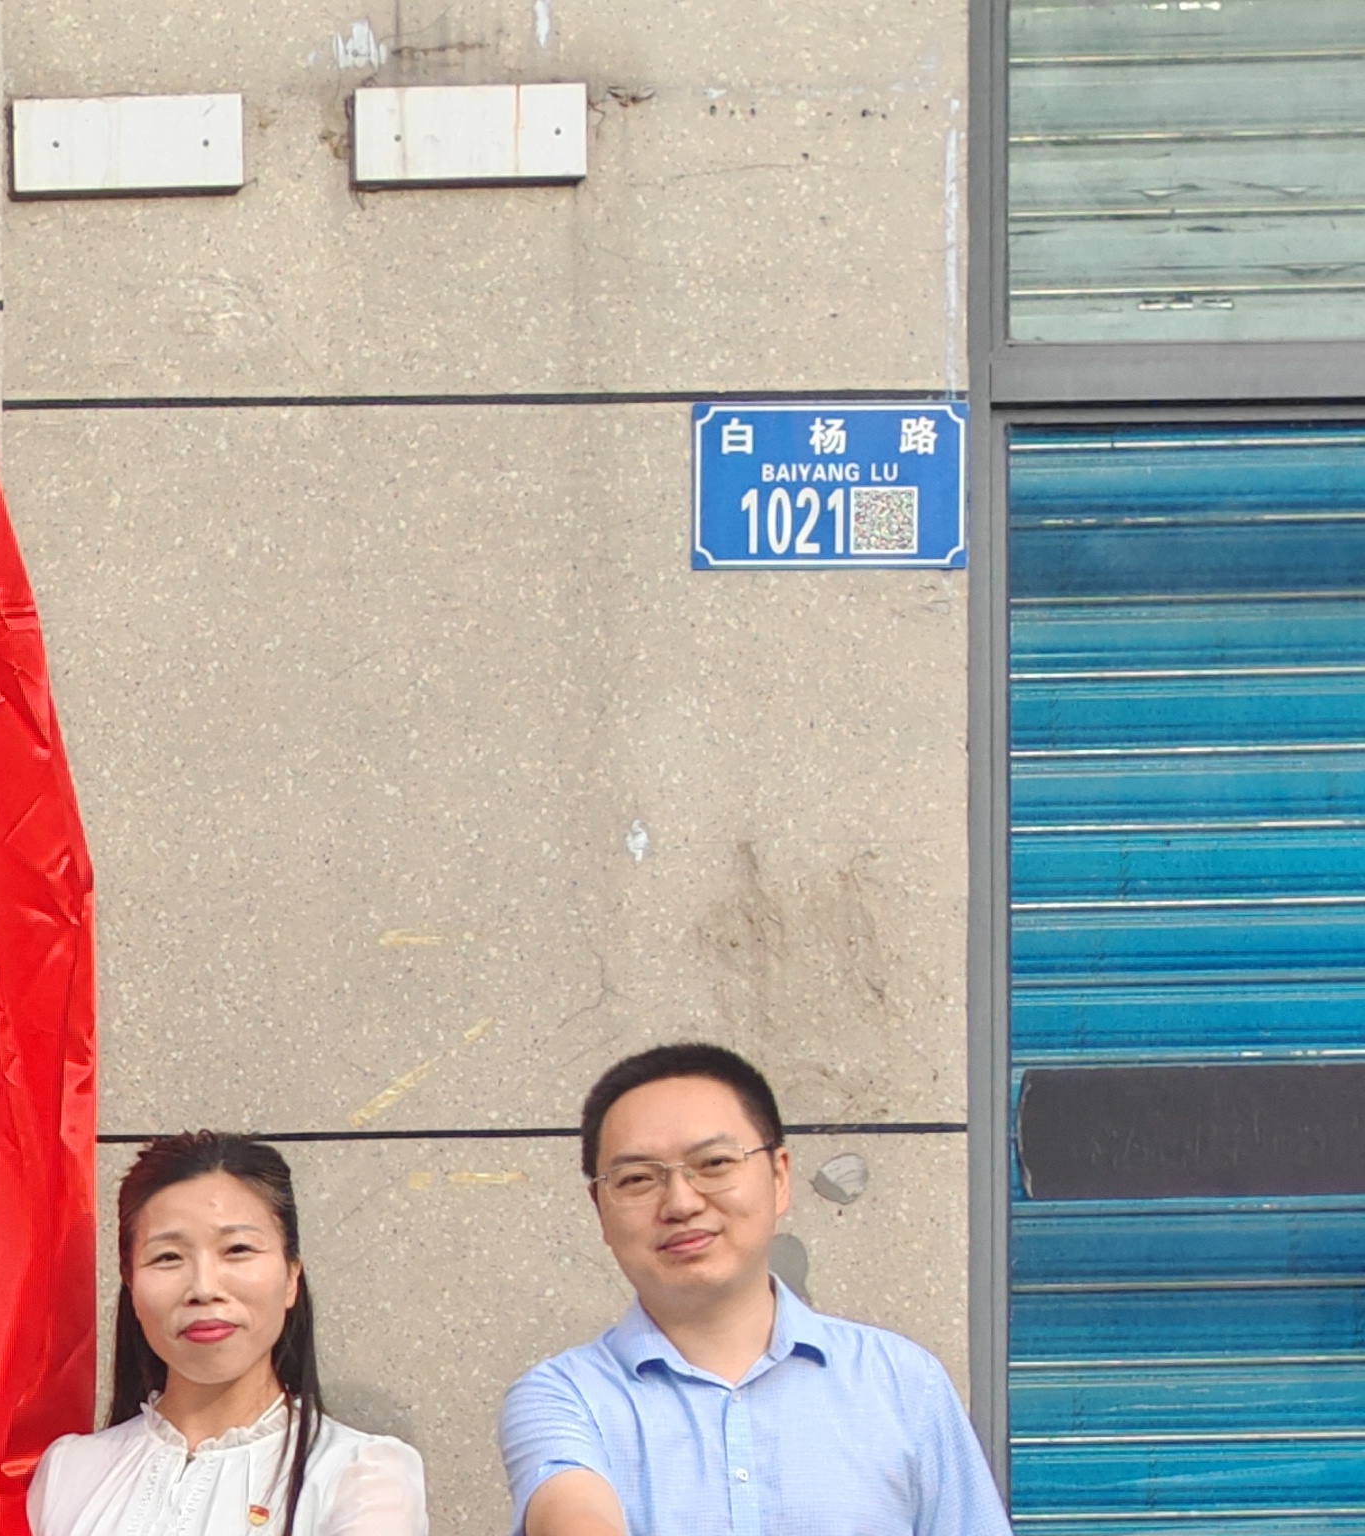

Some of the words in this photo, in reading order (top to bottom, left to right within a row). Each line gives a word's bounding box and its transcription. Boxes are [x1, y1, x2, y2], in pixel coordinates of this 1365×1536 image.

[721, 417, 938, 455] 白杨路
[761, 462, 860, 483] BAIYANG
[871, 462, 899, 482] LU
[741, 486, 845, 555] 1021
